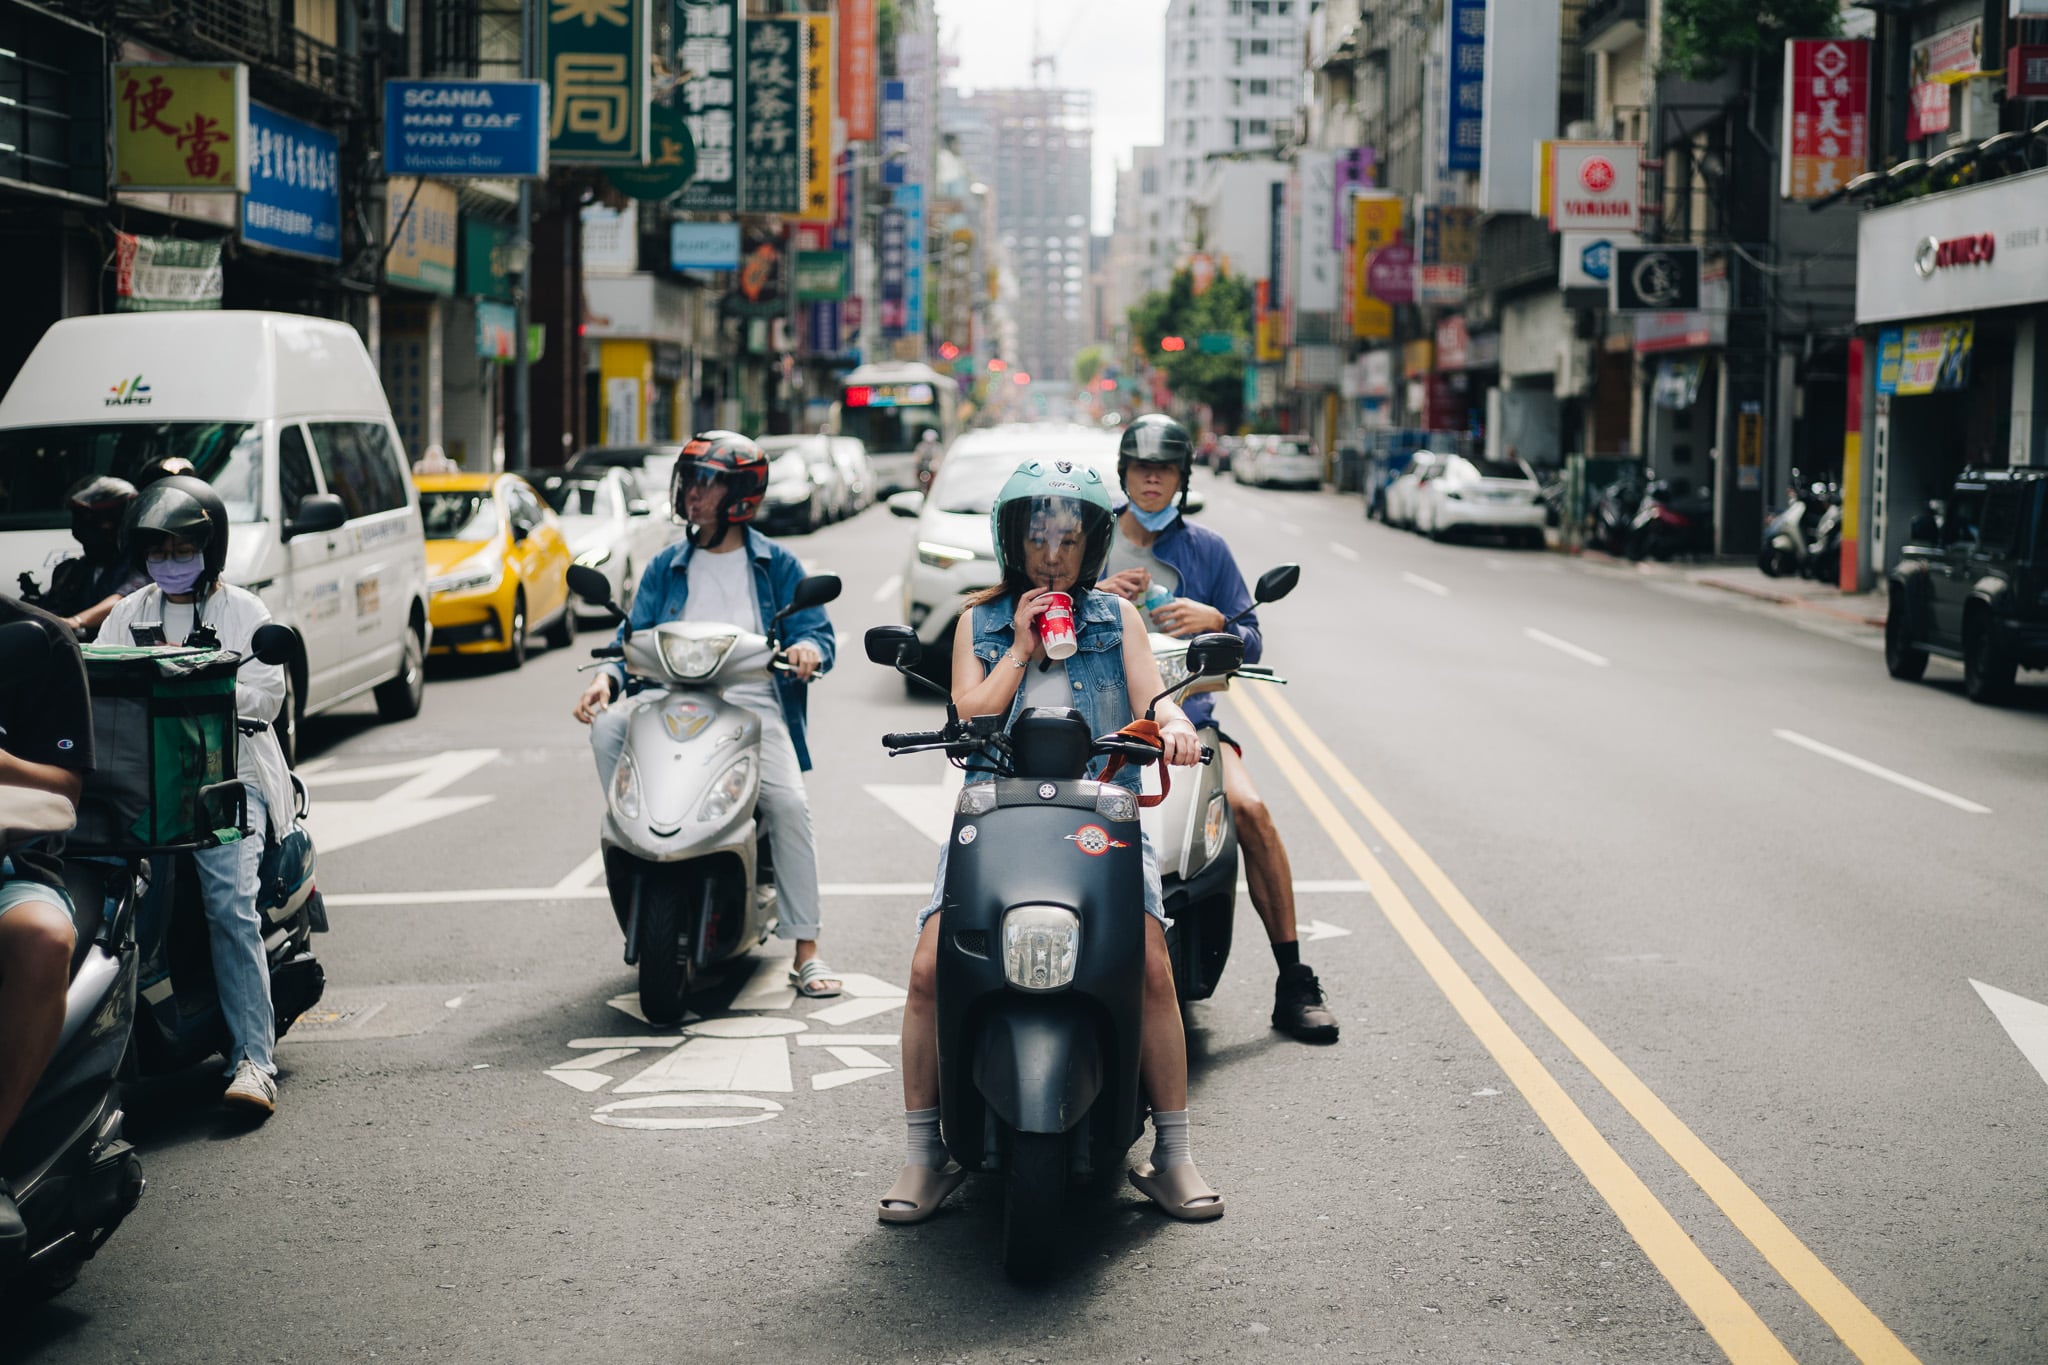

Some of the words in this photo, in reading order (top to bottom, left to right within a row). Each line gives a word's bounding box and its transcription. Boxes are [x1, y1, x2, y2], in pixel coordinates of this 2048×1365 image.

[404, 89, 493, 108] SCANIA
[122, 75, 231, 180] 便當
[403, 113, 454, 127] MAN
[462, 113, 522, 128] DAF
[404, 132, 482, 147] VOLVO
[1564, 201, 1631, 216] YAMAHA
[104, 397, 151, 407] TAIPEI
